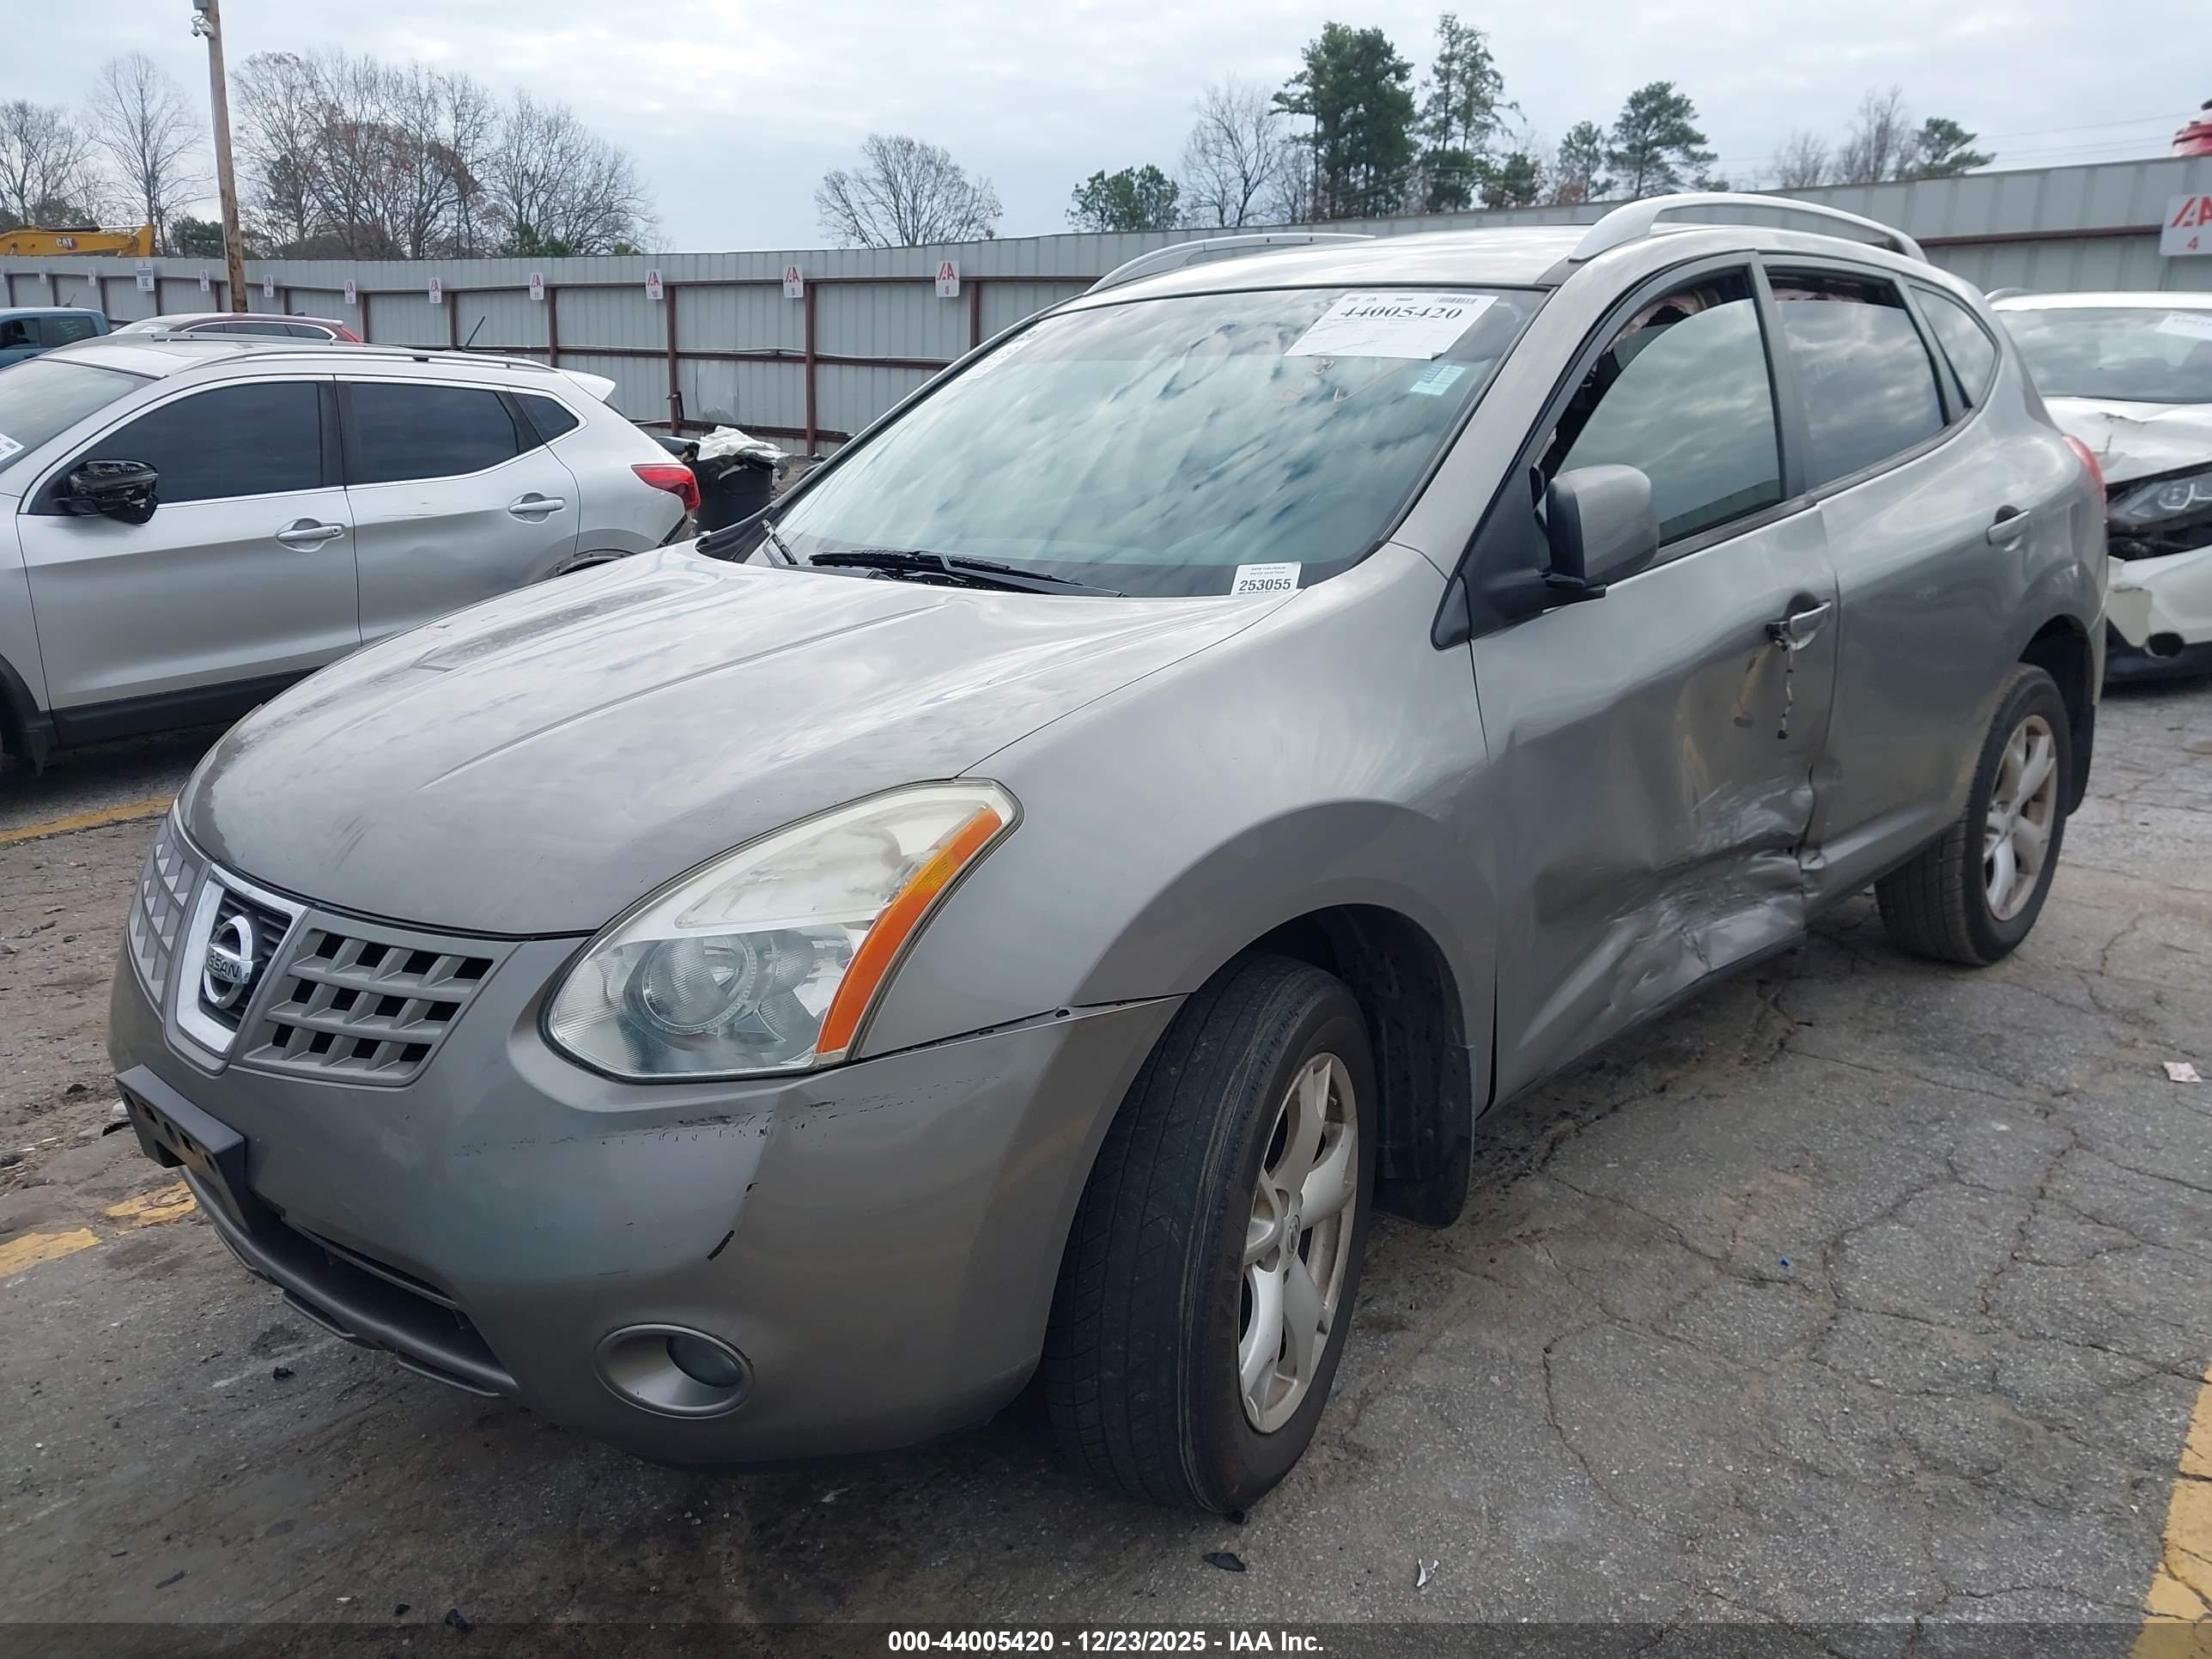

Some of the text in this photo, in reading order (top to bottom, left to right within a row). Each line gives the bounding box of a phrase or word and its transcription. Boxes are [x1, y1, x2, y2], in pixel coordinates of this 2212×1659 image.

[55, 237, 74, 248] CAT
[2187, 236, 2198, 251] 4
[1340, 306, 1462, 319] 44005420
[1238, 578, 1292, 592] 253055
[208, 954, 240, 978] SSAN
